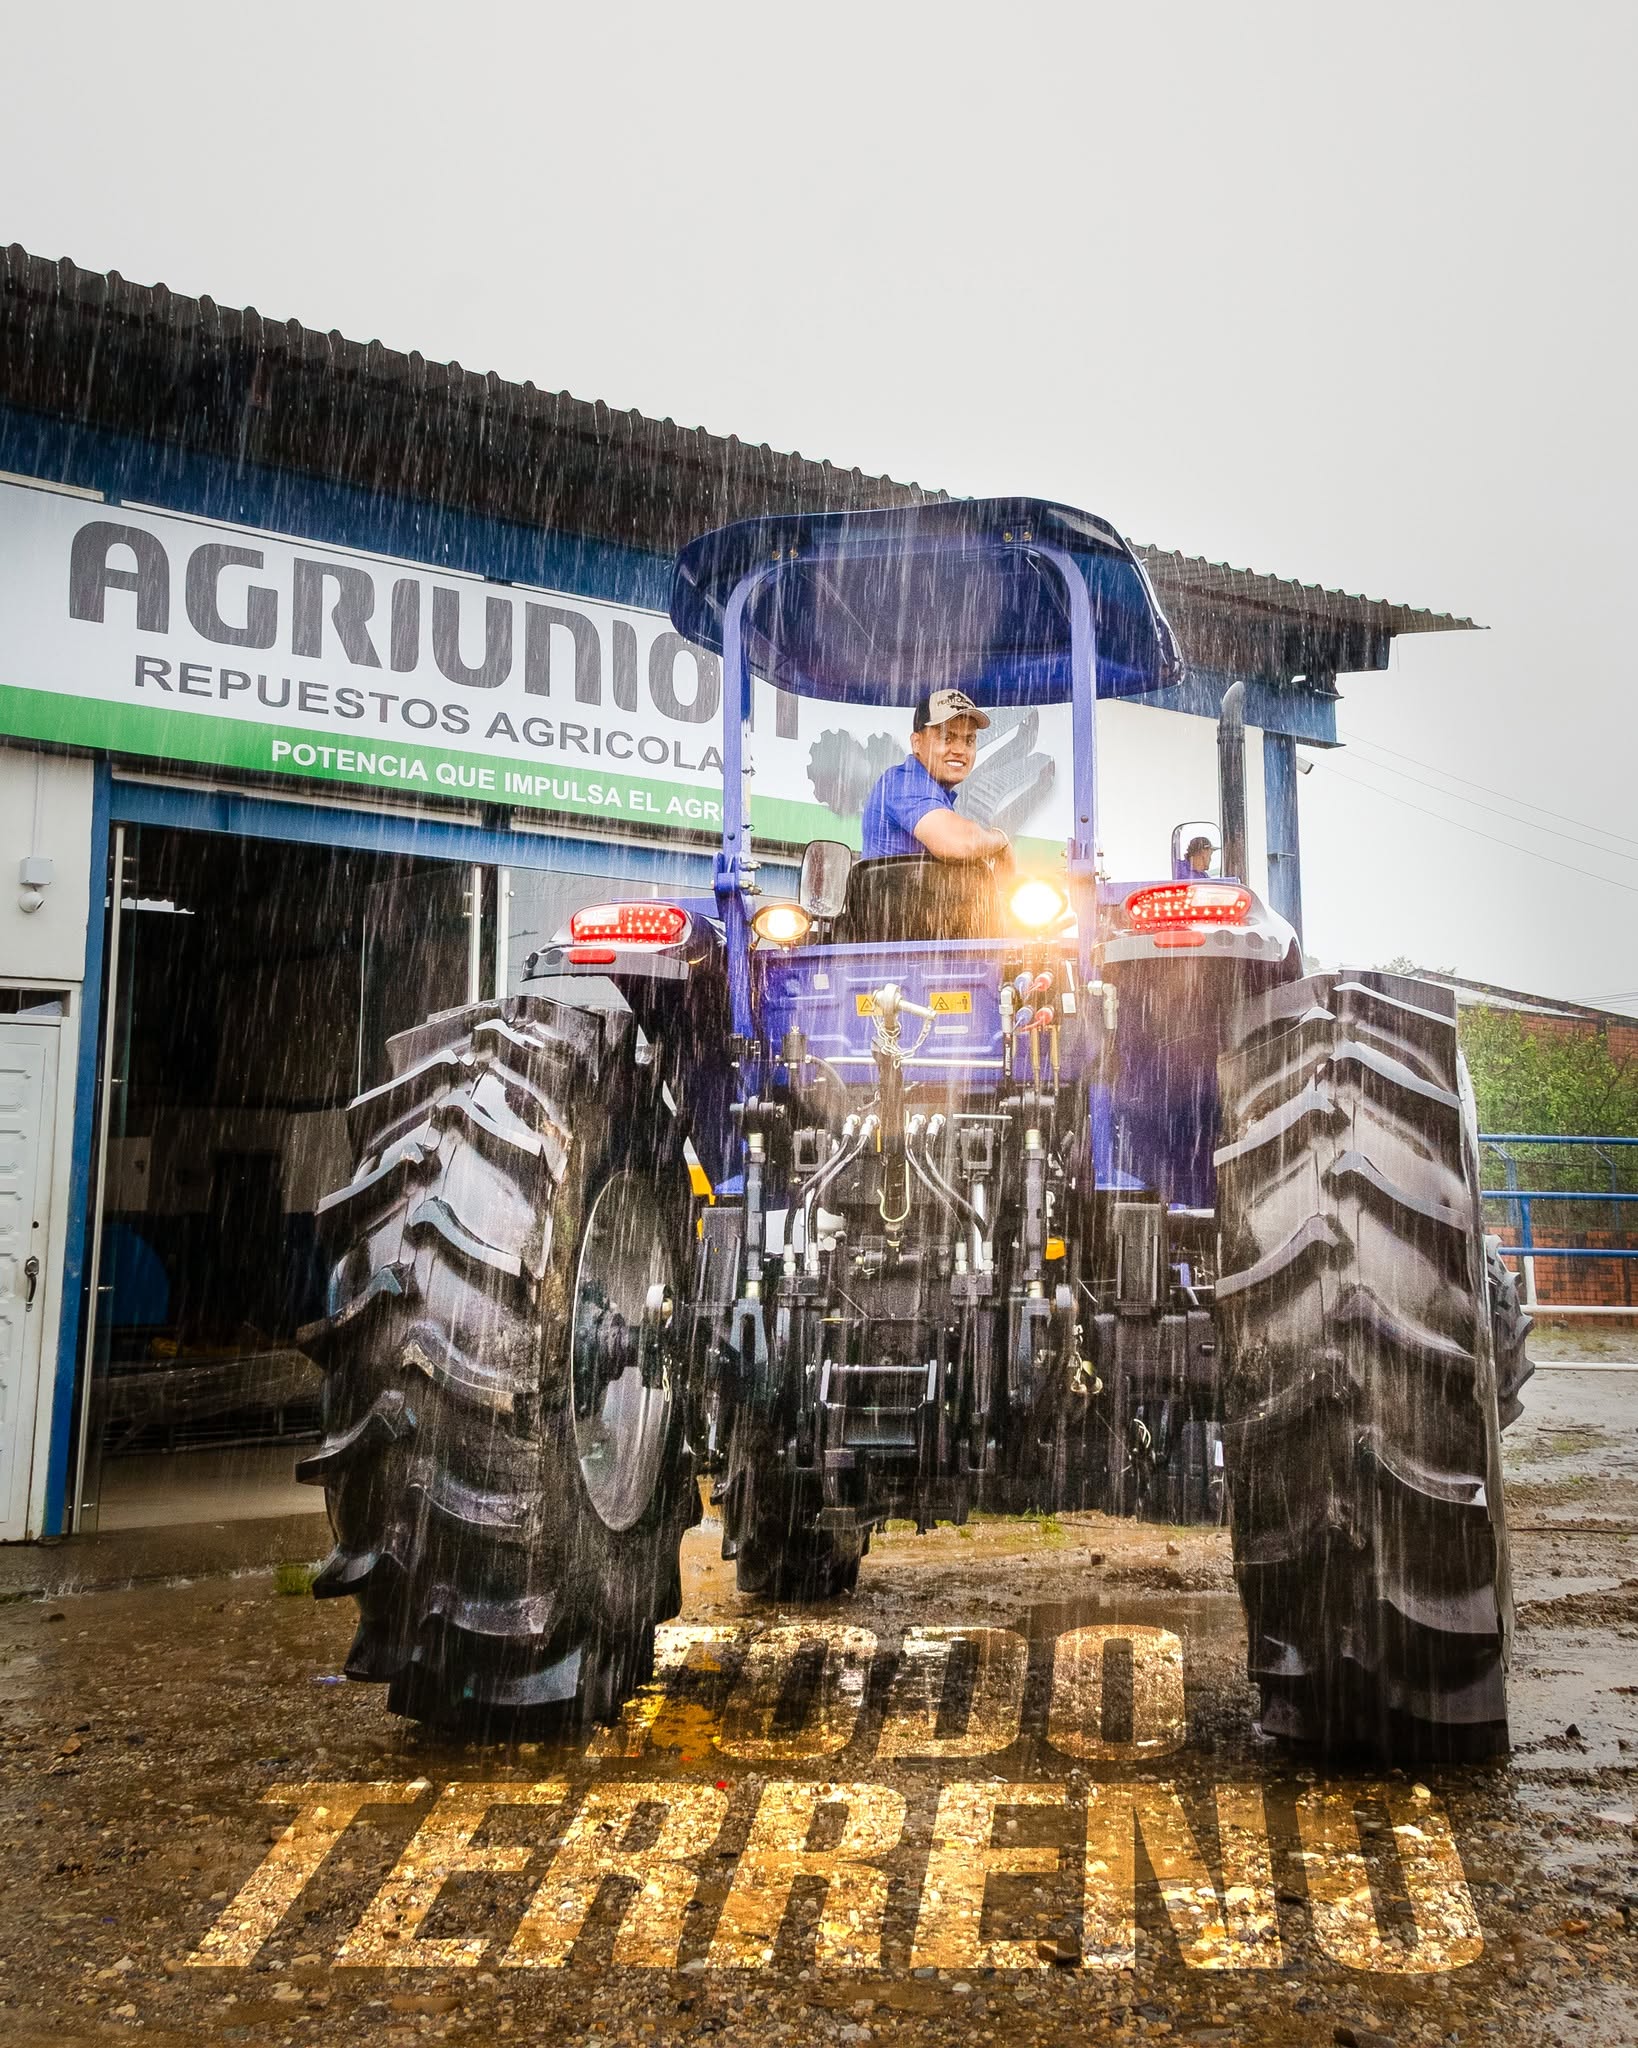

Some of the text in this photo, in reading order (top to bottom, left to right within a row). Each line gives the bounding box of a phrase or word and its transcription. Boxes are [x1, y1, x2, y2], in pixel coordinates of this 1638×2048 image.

[135, 655, 754, 777] REPUESTOS AGRICOLA
[271, 740, 723, 823] POTENCIA QUE IMPULSA EL AGR
